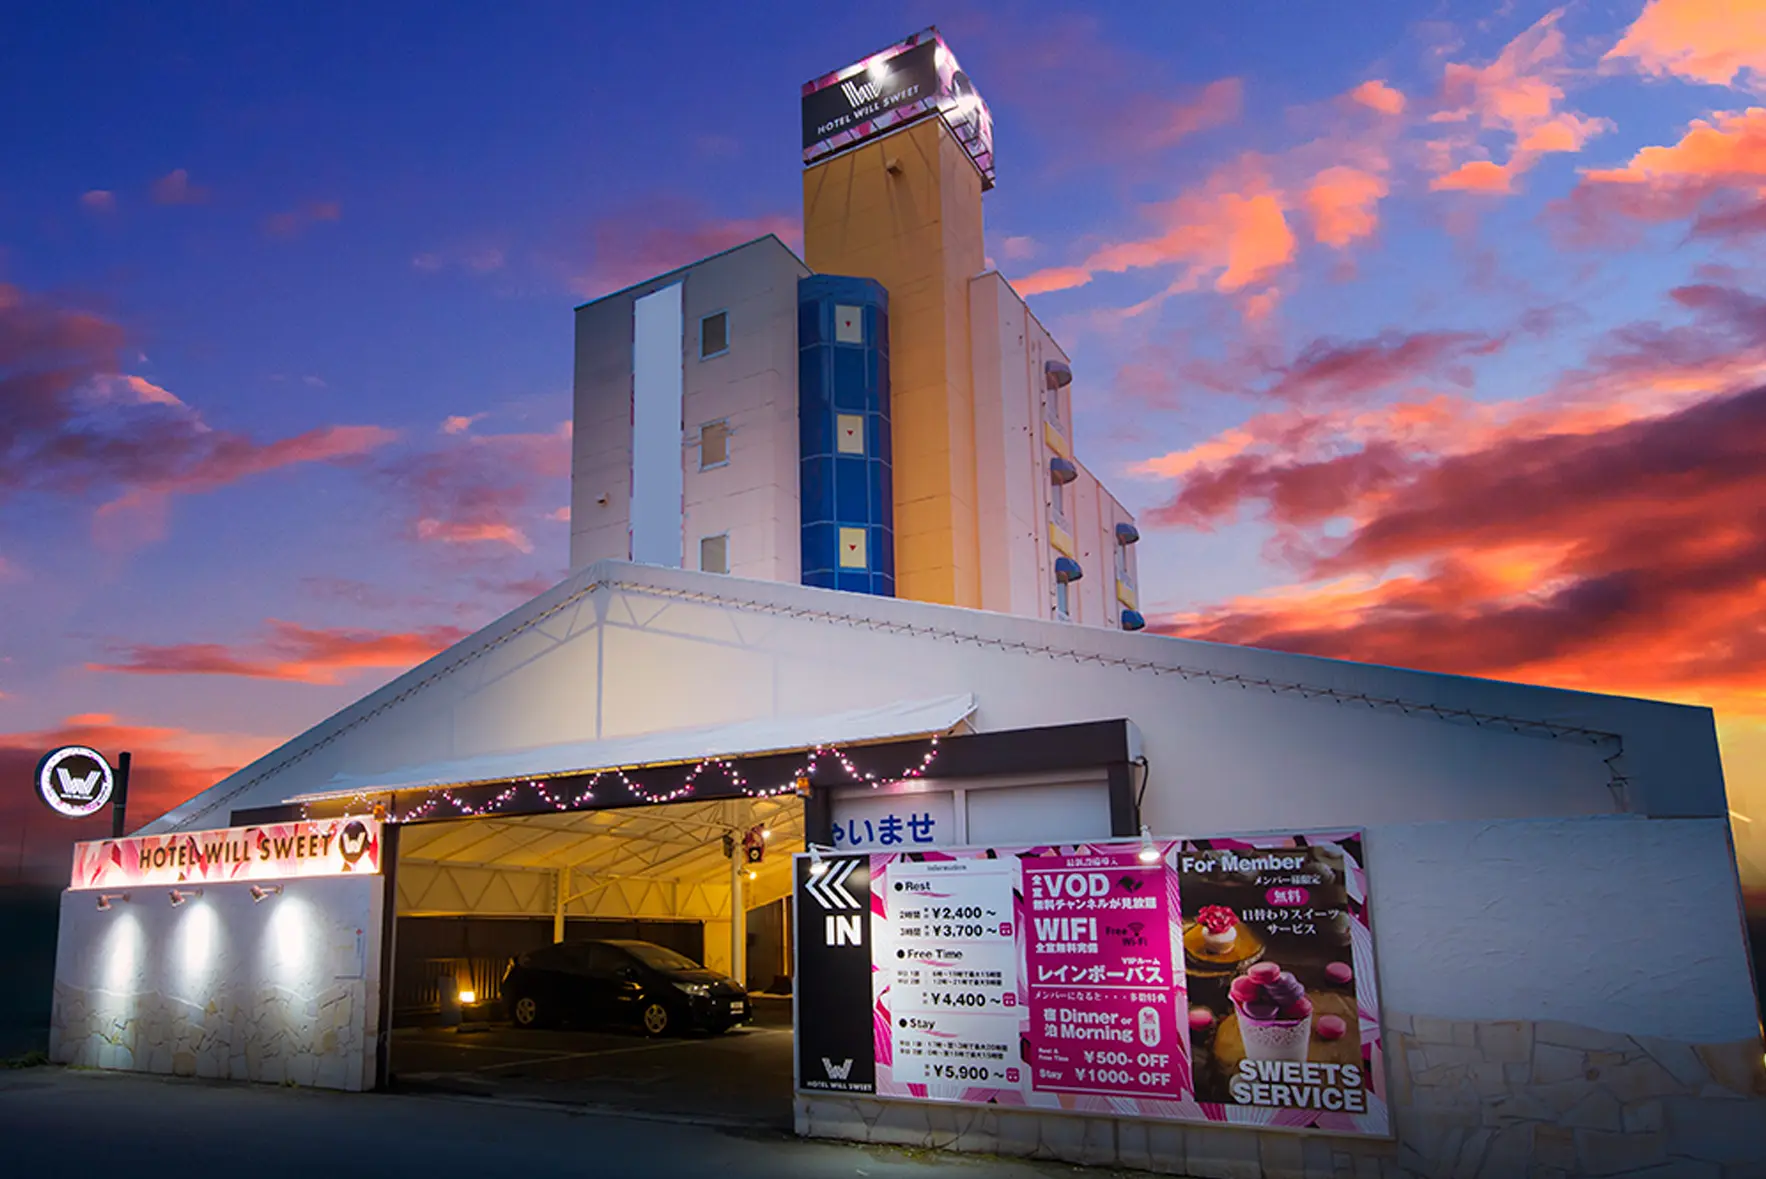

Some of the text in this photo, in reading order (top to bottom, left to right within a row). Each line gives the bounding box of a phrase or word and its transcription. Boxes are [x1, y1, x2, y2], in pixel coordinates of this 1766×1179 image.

[817, 84, 920, 135] HOTEL WILL SWEET
[139, 846, 196, 870] HOTEL
[205, 840, 251, 864] WILL
[259, 833, 332, 861] SWEET
[1182, 854, 1305, 873] For Member
[905, 881, 931, 891] Rest
[1043, 873, 1110, 898] VOD
[1033, 896, 1157, 911] 無料チャンネルが見放題
[1273, 889, 1301, 903] 無料
[1242, 908, 1340, 921] 日替わりスイーツ
[825, 915, 862, 946] IN
[1033, 917, 1098, 941] WIFI
[1105, 926, 1127, 936] Free
[1266, 923, 1317, 936] サービス
[907, 948, 963, 960] Free Time
[1037, 964, 1164, 983] レインボーバス
[910, 1018, 936, 1030] Stay
[1059, 1007, 1132, 1025] Dinner or
[1060, 1024, 1134, 1044] Morning
[1136, 1053, 1169, 1068] OFF
[1039, 1068, 1063, 1081] Stay
[1138, 1072, 1171, 1087] OFF
[1239, 1059, 1361, 1087] SWEETS
[806, 1080, 829, 1089] HOTEL
[1233, 1082, 1364, 1112] SERVICE
